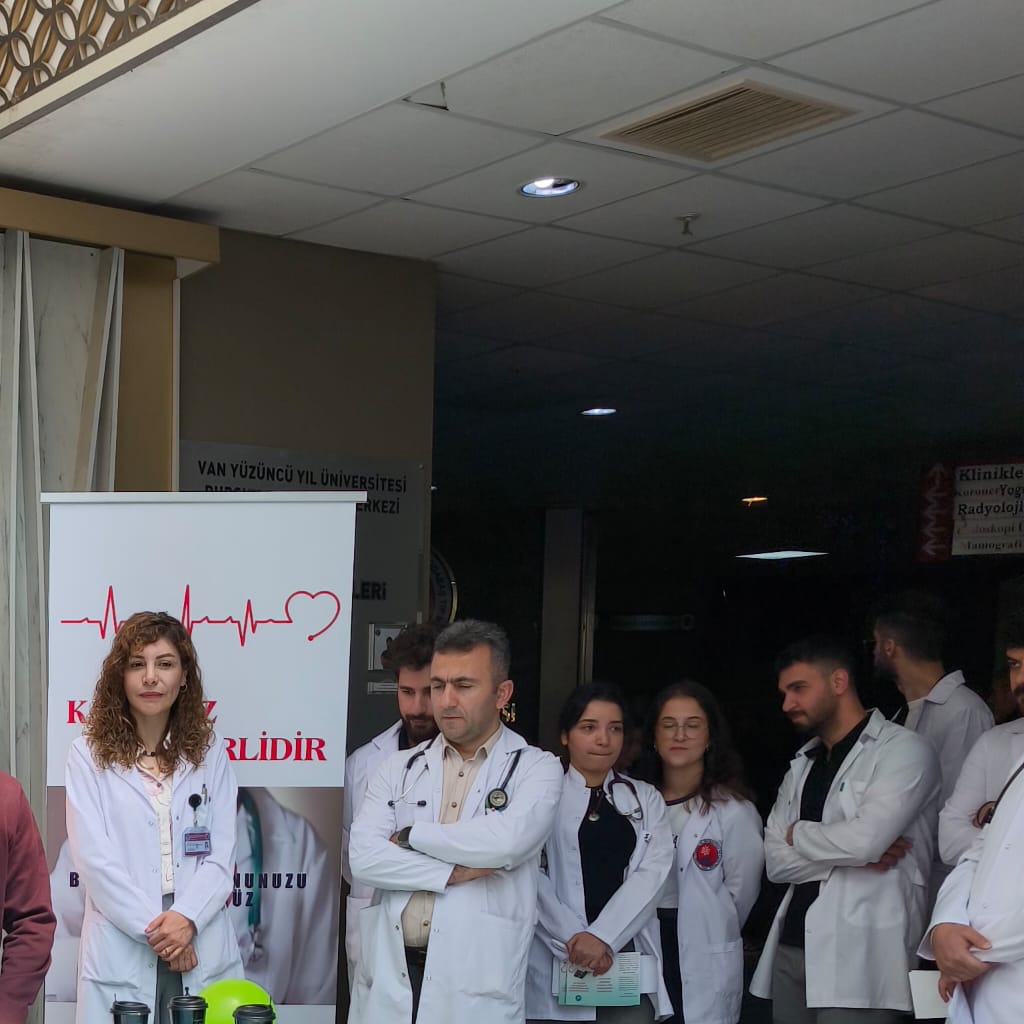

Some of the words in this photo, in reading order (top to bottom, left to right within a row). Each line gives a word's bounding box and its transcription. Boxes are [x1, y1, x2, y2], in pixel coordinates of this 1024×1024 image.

[197, 460, 226, 477] VAN
[230, 460, 293, 483] YÜZÜNCÜ
[297, 470, 317, 486] YIL
[321, 467, 407, 493] ÜNİVERSİTESİ
